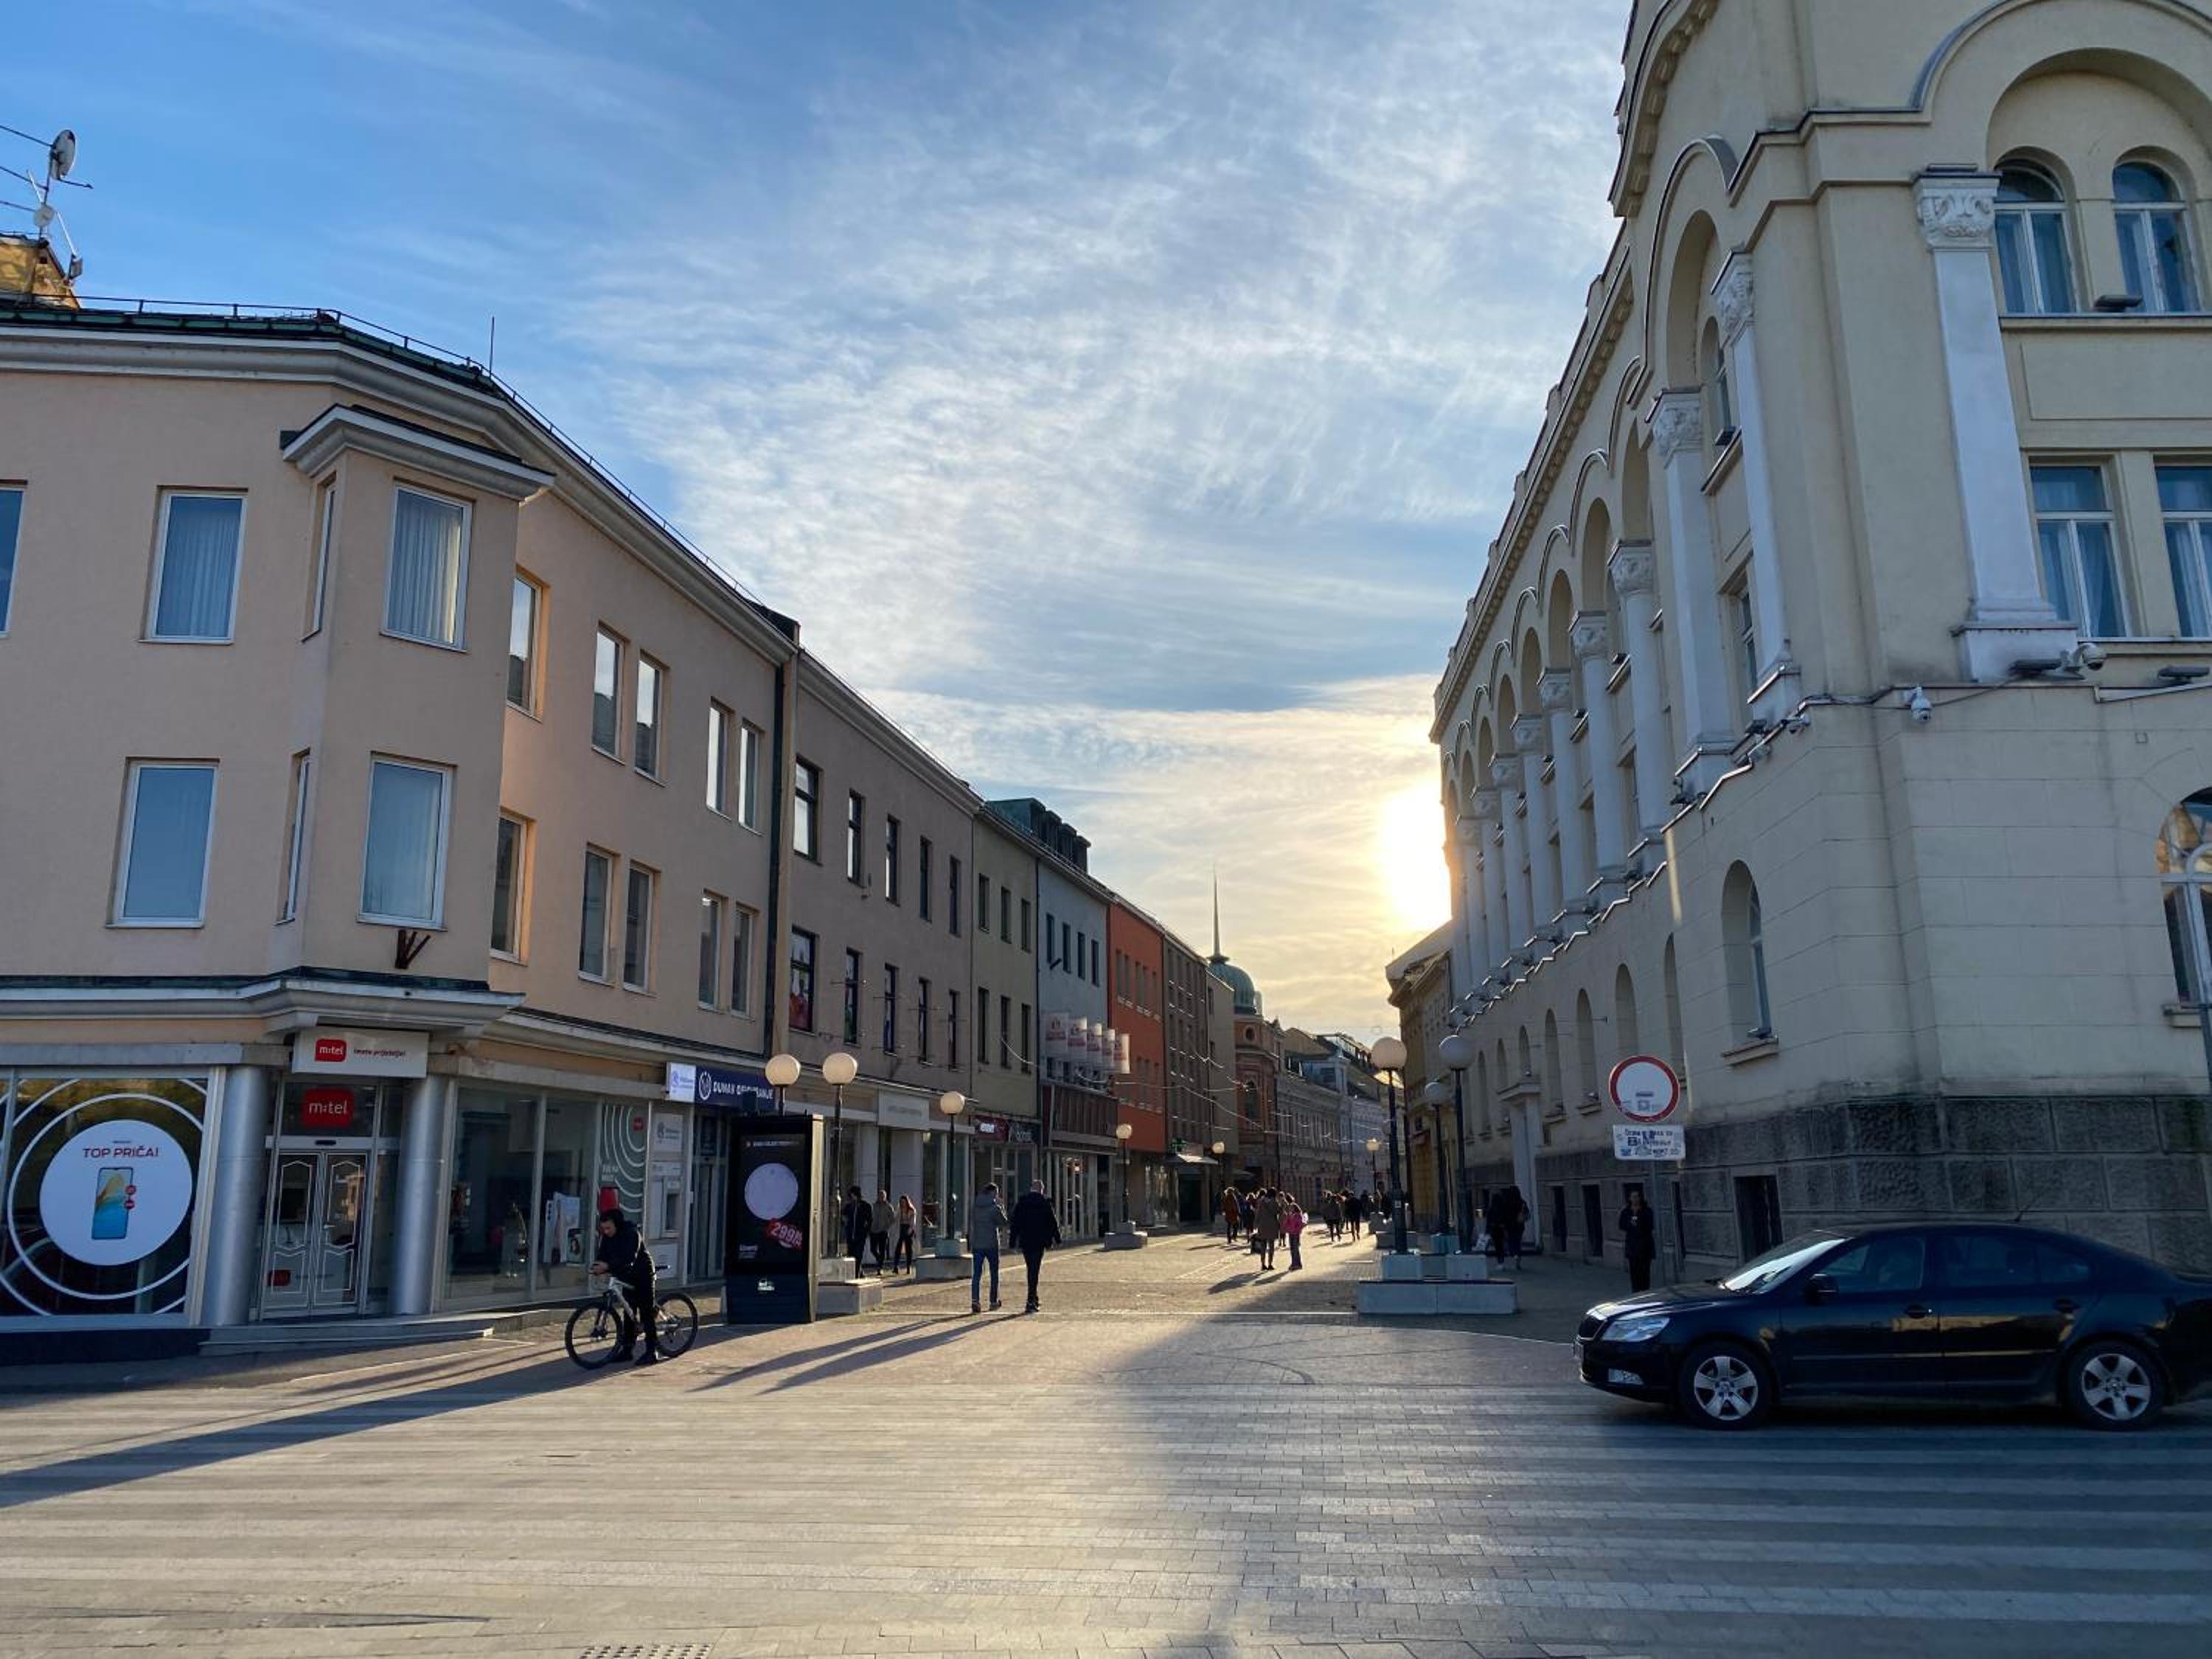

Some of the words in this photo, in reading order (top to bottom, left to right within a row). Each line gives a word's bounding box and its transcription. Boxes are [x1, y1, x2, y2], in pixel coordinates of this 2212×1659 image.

[309, 1099, 348, 1115] m:tel
[83, 1147, 111, 1158] TOP
[113, 1145, 159, 1158] PRIČA!
